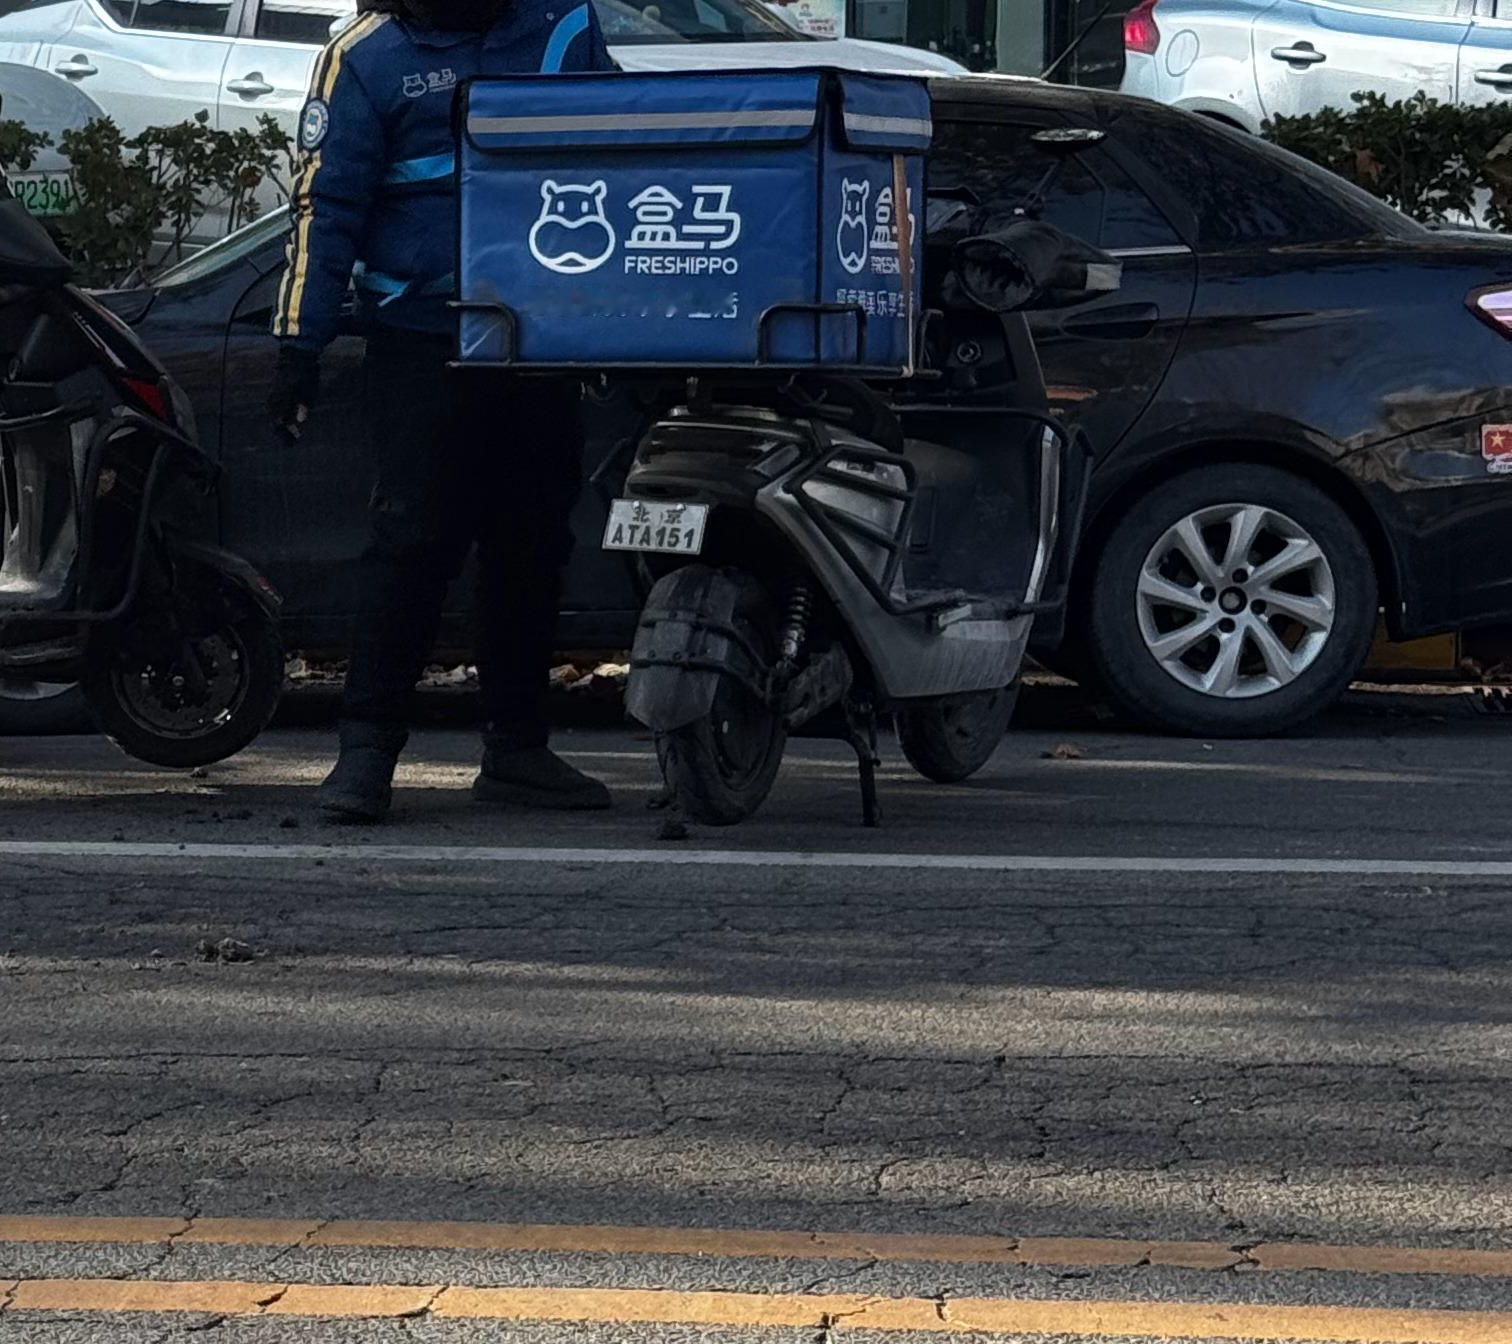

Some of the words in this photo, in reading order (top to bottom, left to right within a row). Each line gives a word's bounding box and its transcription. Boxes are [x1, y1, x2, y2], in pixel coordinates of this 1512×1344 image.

[624, 184, 742, 250] 盒马
[624, 256, 739, 275] FRESHIPPO
[610, 522, 696, 549] ATA151
